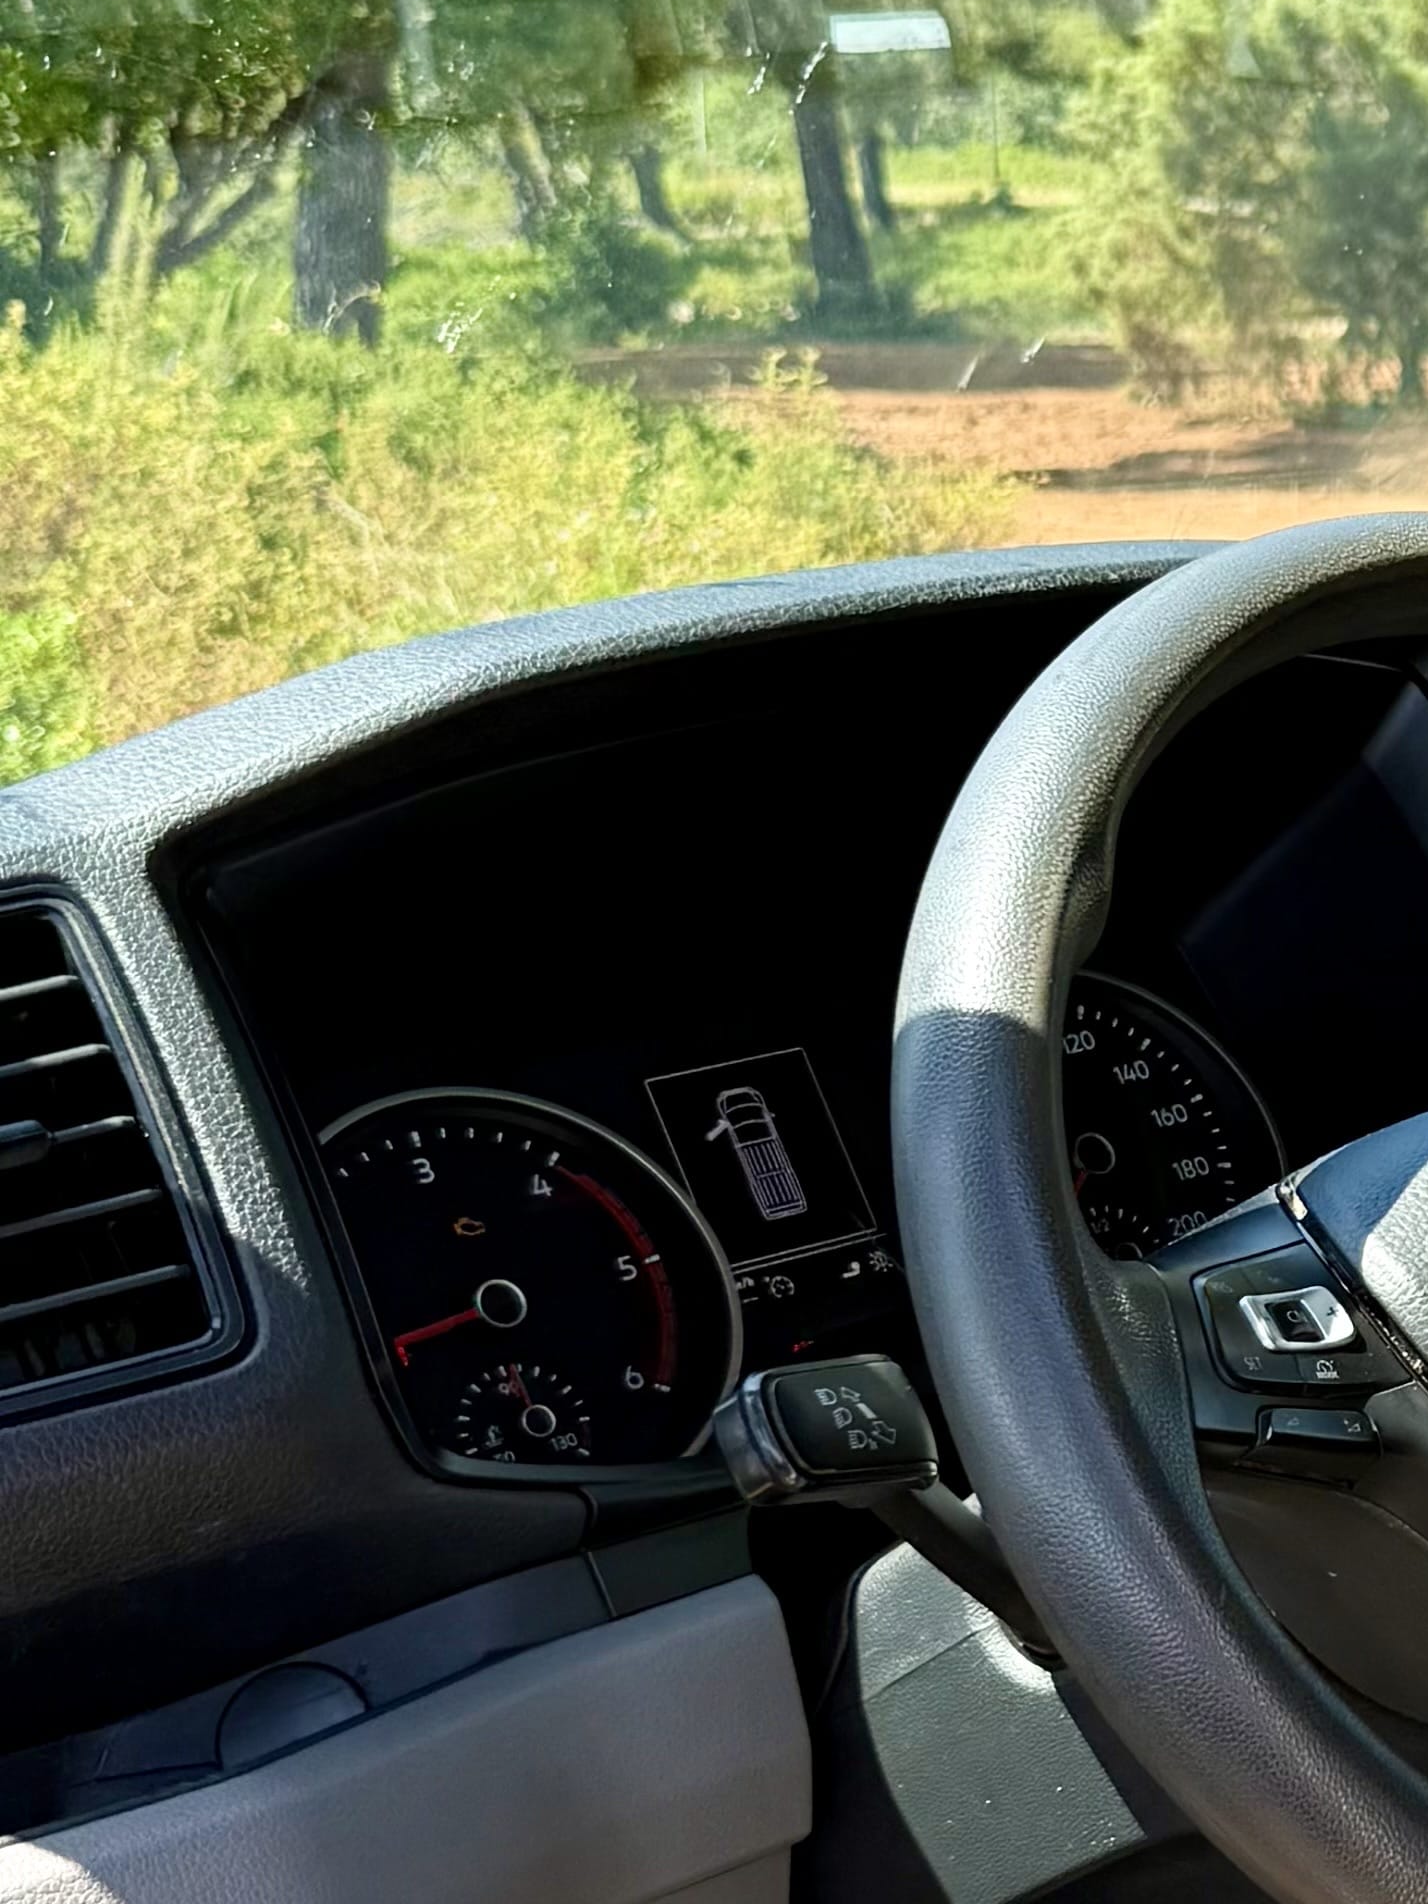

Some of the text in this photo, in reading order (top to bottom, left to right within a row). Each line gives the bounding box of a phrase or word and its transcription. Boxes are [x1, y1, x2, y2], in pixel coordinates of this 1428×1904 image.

[1063, 1030, 1096, 1055] 120
[1113, 1060, 1150, 1084] 140
[1150, 1104, 1189, 1128] 160
[411, 1158, 436, 1184] 3
[1172, 1156, 1210, 1181] 180
[530, 1174, 553, 1198] 4
[616, 1256, 638, 1282] 5
[625, 1365, 645, 1390] 6
[551, 1433, 578, 1451] 130
